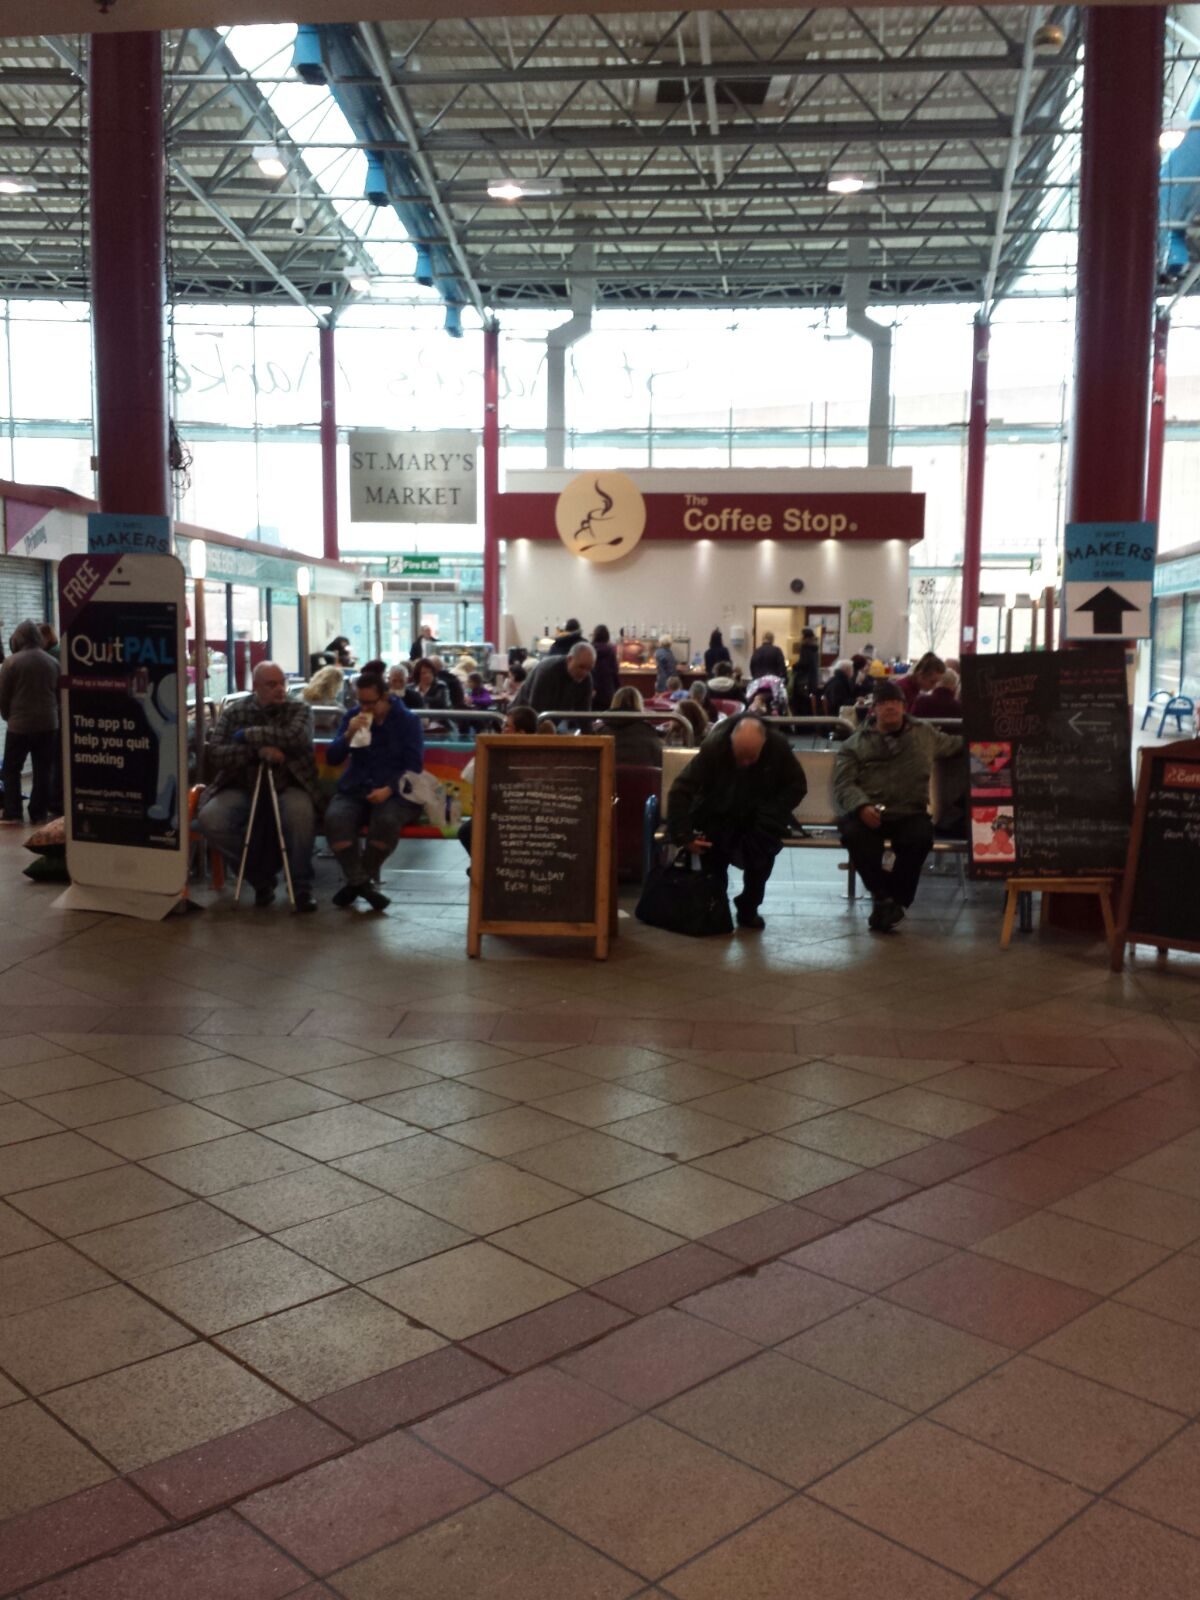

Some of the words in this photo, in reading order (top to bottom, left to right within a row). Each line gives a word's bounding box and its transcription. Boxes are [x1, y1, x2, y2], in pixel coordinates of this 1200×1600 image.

[352, 451, 474, 472] ST.MARY'S
[365, 486, 461, 506] MARKET
[684, 494, 708, 506] The
[683, 508, 772, 532] Coffee
[88, 531, 169, 552] MAKERS
[1066, 542, 1154, 564] MAKERS
[404, 560, 420, 569] Fire
[422, 560, 438, 569] Exit
[63, 559, 100, 607] FREE
[71, 634, 175, 665] QuitPAL
[73, 715, 95, 728] The
[97, 719, 120, 732] app
[123, 718, 136, 730] to
[74, 733, 99, 748] help
[102, 737, 123, 750] you
[126, 737, 150, 751] quit
[74, 753, 125, 768] smoking
[496, 867, 527, 879] SERVED
[547, 871, 565, 880] DAY
[504, 881, 528, 893] EVERY
